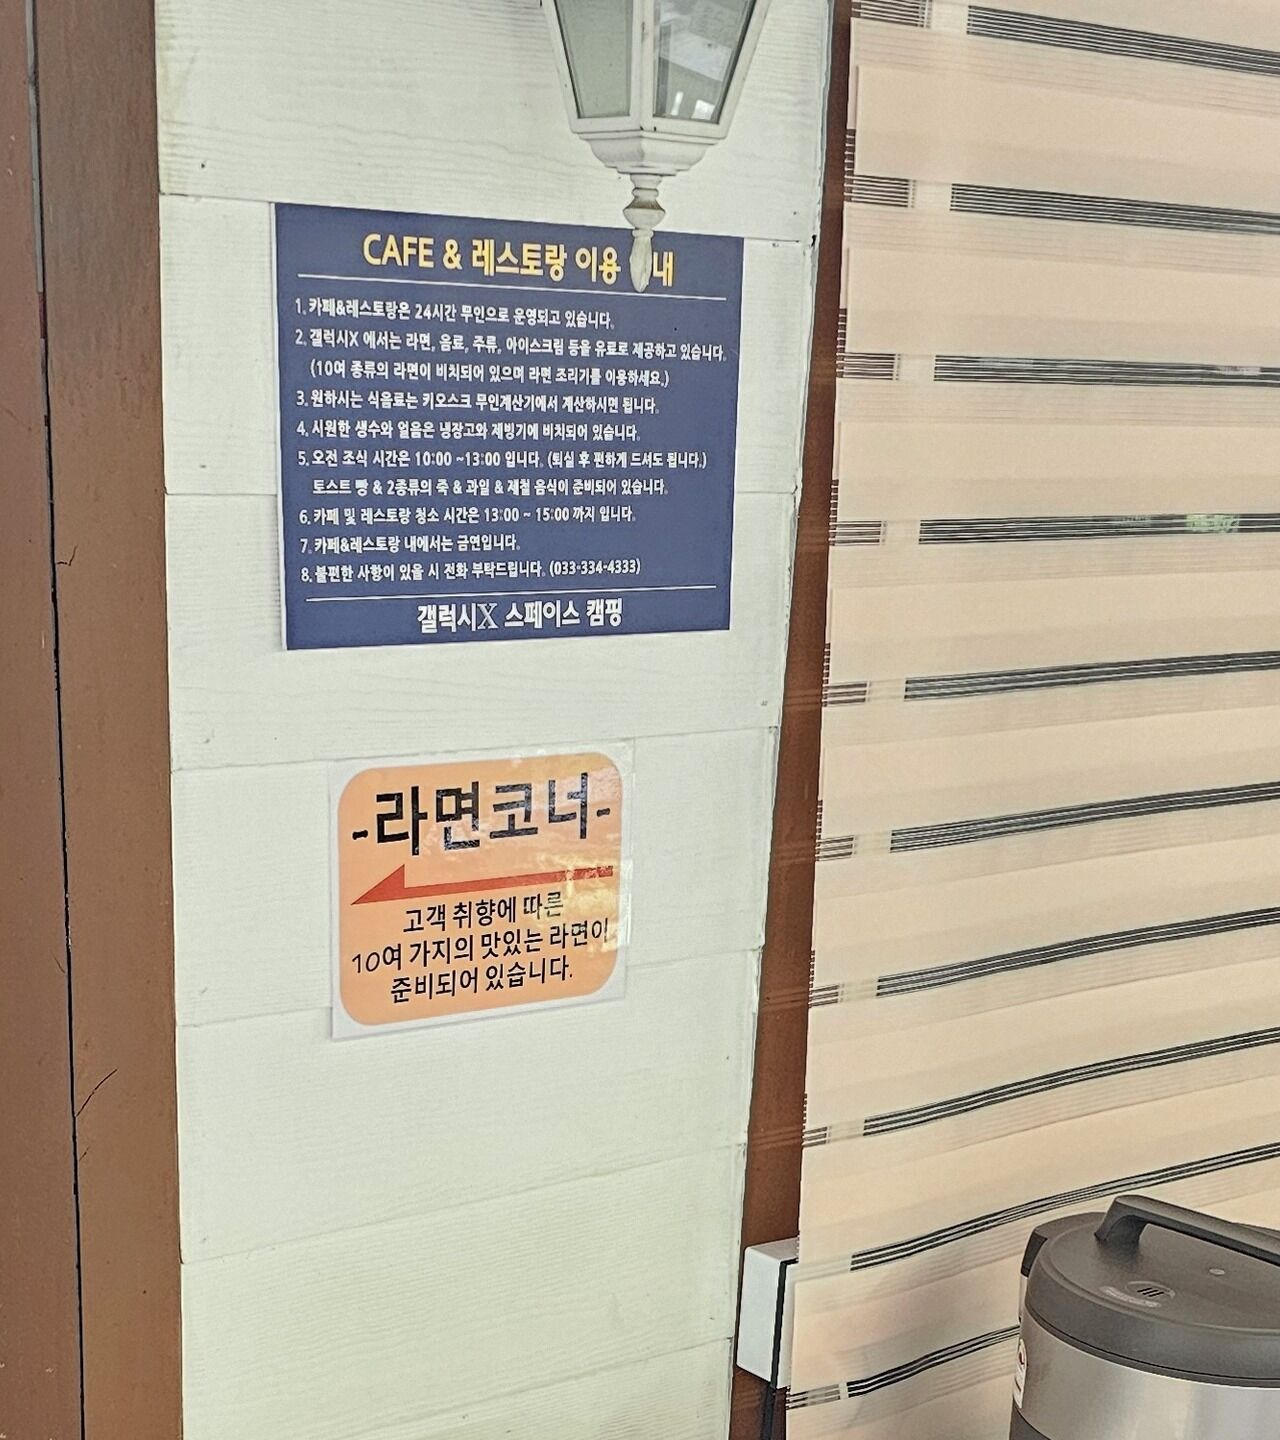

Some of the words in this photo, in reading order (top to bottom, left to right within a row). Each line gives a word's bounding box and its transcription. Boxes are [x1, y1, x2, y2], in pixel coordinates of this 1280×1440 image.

[363, 233, 434, 268] CAFE
[443, 246, 462, 270] &
[472, 238, 568, 281] 레스토랑
[576, 246, 621, 286] 이용
[651, 250, 675, 287] 내
[296, 298, 306, 315] 1.
[309, 297, 410, 320] 카페&레스토랑은
[415, 304, 457, 322] 24시간
[565, 310, 614, 329] 있습니다.
[296, 329, 307, 346] 2.
[310, 328, 359, 348] 갤럭시X
[363, 331, 401, 349] 에서는
[406, 332, 435, 352] 라면,
[439, 334, 469, 353] 음료,
[473, 336, 501, 354] 주류,
[506, 337, 563, 355] 아이스크림
[568, 339, 591, 357] 등을
[595, 340, 629, 357] 유료로
[632, 342, 677, 360] 제공하고
[680, 343, 726, 361] 있습니다.
[311, 359, 345, 378] (10여
[351, 361, 388, 379] 종류의
[394, 362, 431, 380] 라면이
[436, 364, 484, 382] 비치되어
[489, 365, 524, 383] 있으며
[529, 366, 551, 384] 라면
[555, 368, 601, 385] 조리기를
[605, 369, 669, 388] 이용하세요.)
[297, 390, 308, 406] 3.
[311, 390, 363, 408] 원하시는
[368, 391, 418, 409] 식음료는
[423, 392, 472, 410] 키오스크
[476, 393, 557, 412] 무인계산기에서
[562, 396, 618, 413] 계산하시면
[623, 397, 659, 414] 됩니다.
[297, 421, 308, 437] 4.
[312, 419, 351, 438] 시원한
[355, 420, 393, 438] 생수와
[440, 422, 489, 440] 냉장고와
[491, 422, 538, 440] 제빙기에
[543, 423, 587, 440] 비치되어
[593, 424, 640, 441] 있습니다.
[299, 451, 309, 466] 5.
[312, 449, 337, 467] 오전
[342, 450, 367, 467] 조식
[373, 450, 410, 467] 시간은
[416, 451, 452, 466] 10:00
[505, 451, 543, 468] 입니다.
[548, 451, 574, 468] (퇴실
[578, 451, 590, 468] 후
[594, 451, 627, 468] 편하게
[630, 452, 663, 468] 드셔도
[313, 480, 351, 494] 토스트
[355, 479, 368, 496] 빵
[373, 480, 382, 495] &
[387, 479, 432, 496] 2종류의
[436, 479, 449, 495] 죽
[453, 480, 462, 494] &
[466, 479, 489, 496] 과일
[495, 480, 504, 494] &
[507, 479, 530, 496] 제철
[534, 479, 568, 495] 음식이
[573, 479, 616, 495] 준비되어
[622, 479, 668, 495] 있습니다.
[300, 510, 311, 525] 6.
[314, 508, 339, 525] 카페
[344, 508, 356, 525] 및
[361, 507, 411, 525] 레스토랑
[415, 507, 439, 524] 청소
[444, 507, 479, 524] 시간은
[484, 508, 519, 521] 13:00
[536, 507, 569, 521] 15:00
[573, 506, 595, 522] 까지
[600, 506, 635, 521] 입니다.
[301, 539, 312, 553] 7.
[315, 536, 400, 554] 카페&레스토랑
[405, 535, 453, 552] 내에서는
[457, 534, 520, 551] 금연입니다.
[302, 567, 312, 582] 8.
[315, 565, 353, 583] 불편한
[358, 564, 394, 582] 사항이
[400, 564, 424, 580] 있을
[428, 563, 439, 579] 시
[444, 563, 468, 579] 전화
[472, 561, 545, 578] 부탁드립니다.
[550, 558, 640, 577] (033-334-4333)
[417, 602, 499, 634] 갤럭시X
[504, 599, 581, 630] 스페이스
[586, 597, 624, 627] 캠핑
[352, 772, 611, 856] -라면코너-
[403, 905, 446, 933] 고객
[453, 897, 516, 929] 취향에
[523, 891, 564, 920] 따른
[352, 943, 402, 975] 10여
[409, 938, 474, 967] 가지의
[481, 929, 543, 958] 맛있는
[549, 918, 609, 949] 라면이
[390, 967, 479, 1004] 준비되어
[485, 955, 573, 992] 있습니다.
